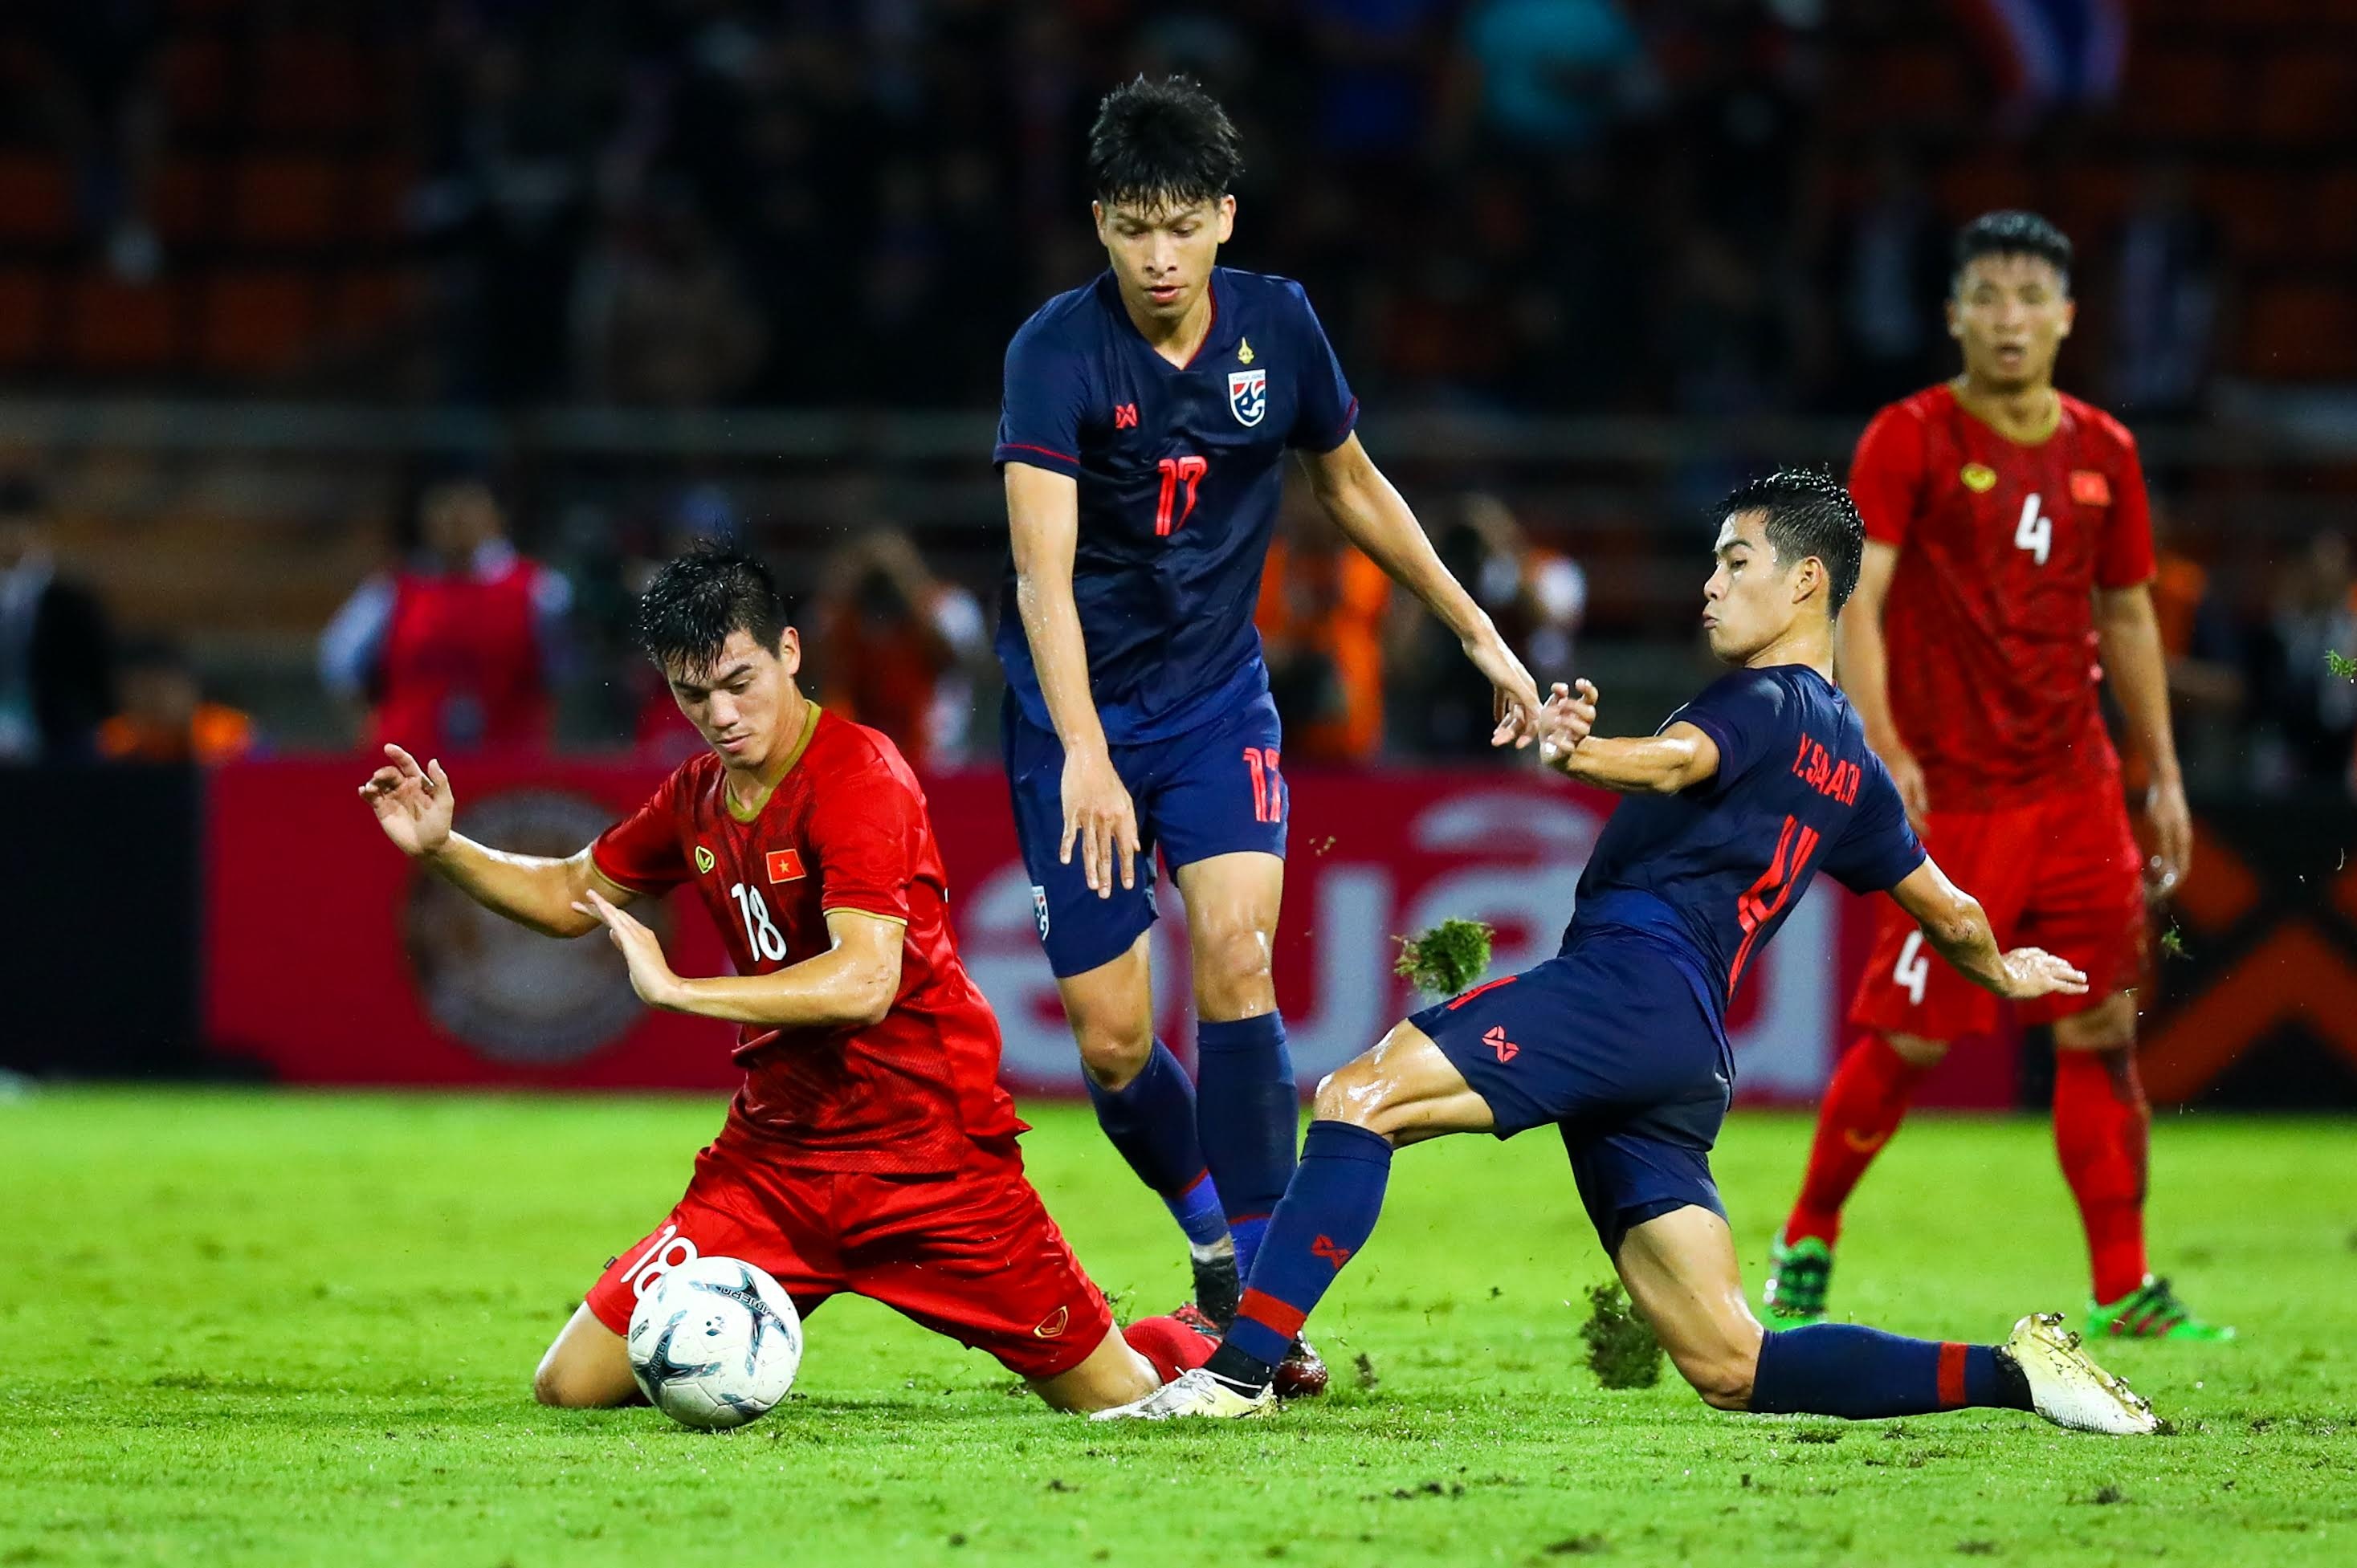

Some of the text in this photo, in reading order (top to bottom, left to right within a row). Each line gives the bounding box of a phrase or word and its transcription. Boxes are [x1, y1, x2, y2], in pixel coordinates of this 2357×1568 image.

[1156, 456, 1207, 536] 17
[2014, 492, 2052, 565] 4
[731, 883, 787, 961] 18
[1894, 930, 1929, 1006] 4
[620, 1224, 698, 1299] 18
